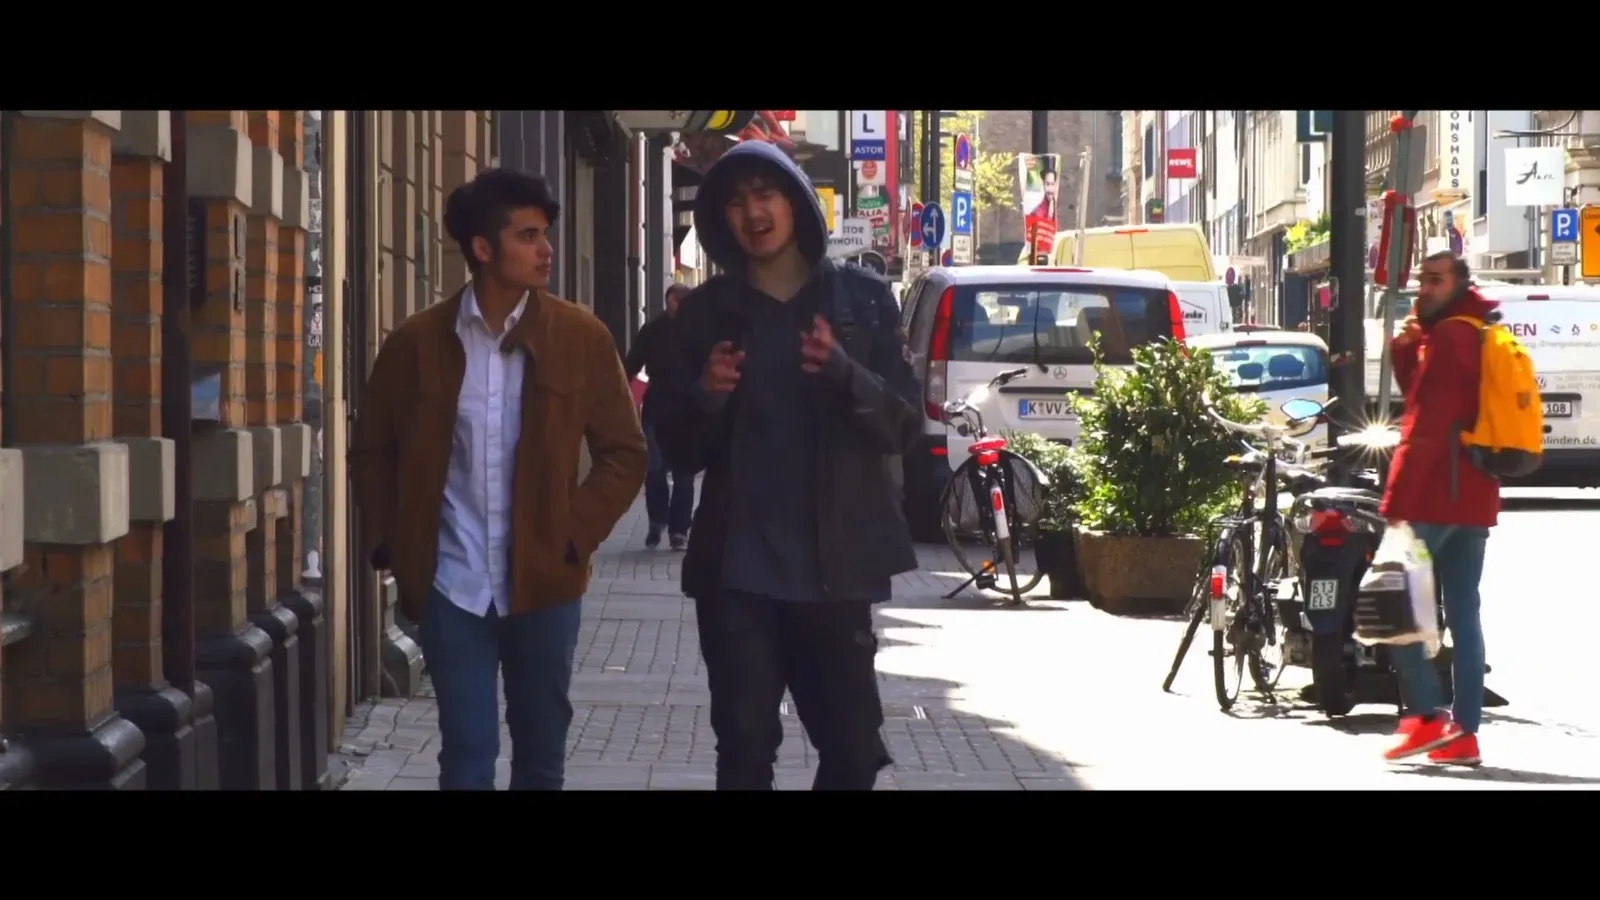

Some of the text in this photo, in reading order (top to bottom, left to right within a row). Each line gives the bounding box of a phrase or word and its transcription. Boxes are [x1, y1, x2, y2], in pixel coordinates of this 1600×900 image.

[854, 146, 884, 155] ASTOR
[1169, 159, 1193, 167] REWE
[957, 197, 968, 227] P
[1557, 213, 1571, 237] P
[1546, 403, 1566, 414] 108
[1312, 581, 1334, 594] 613
[1312, 595, 1333, 608] ELS
